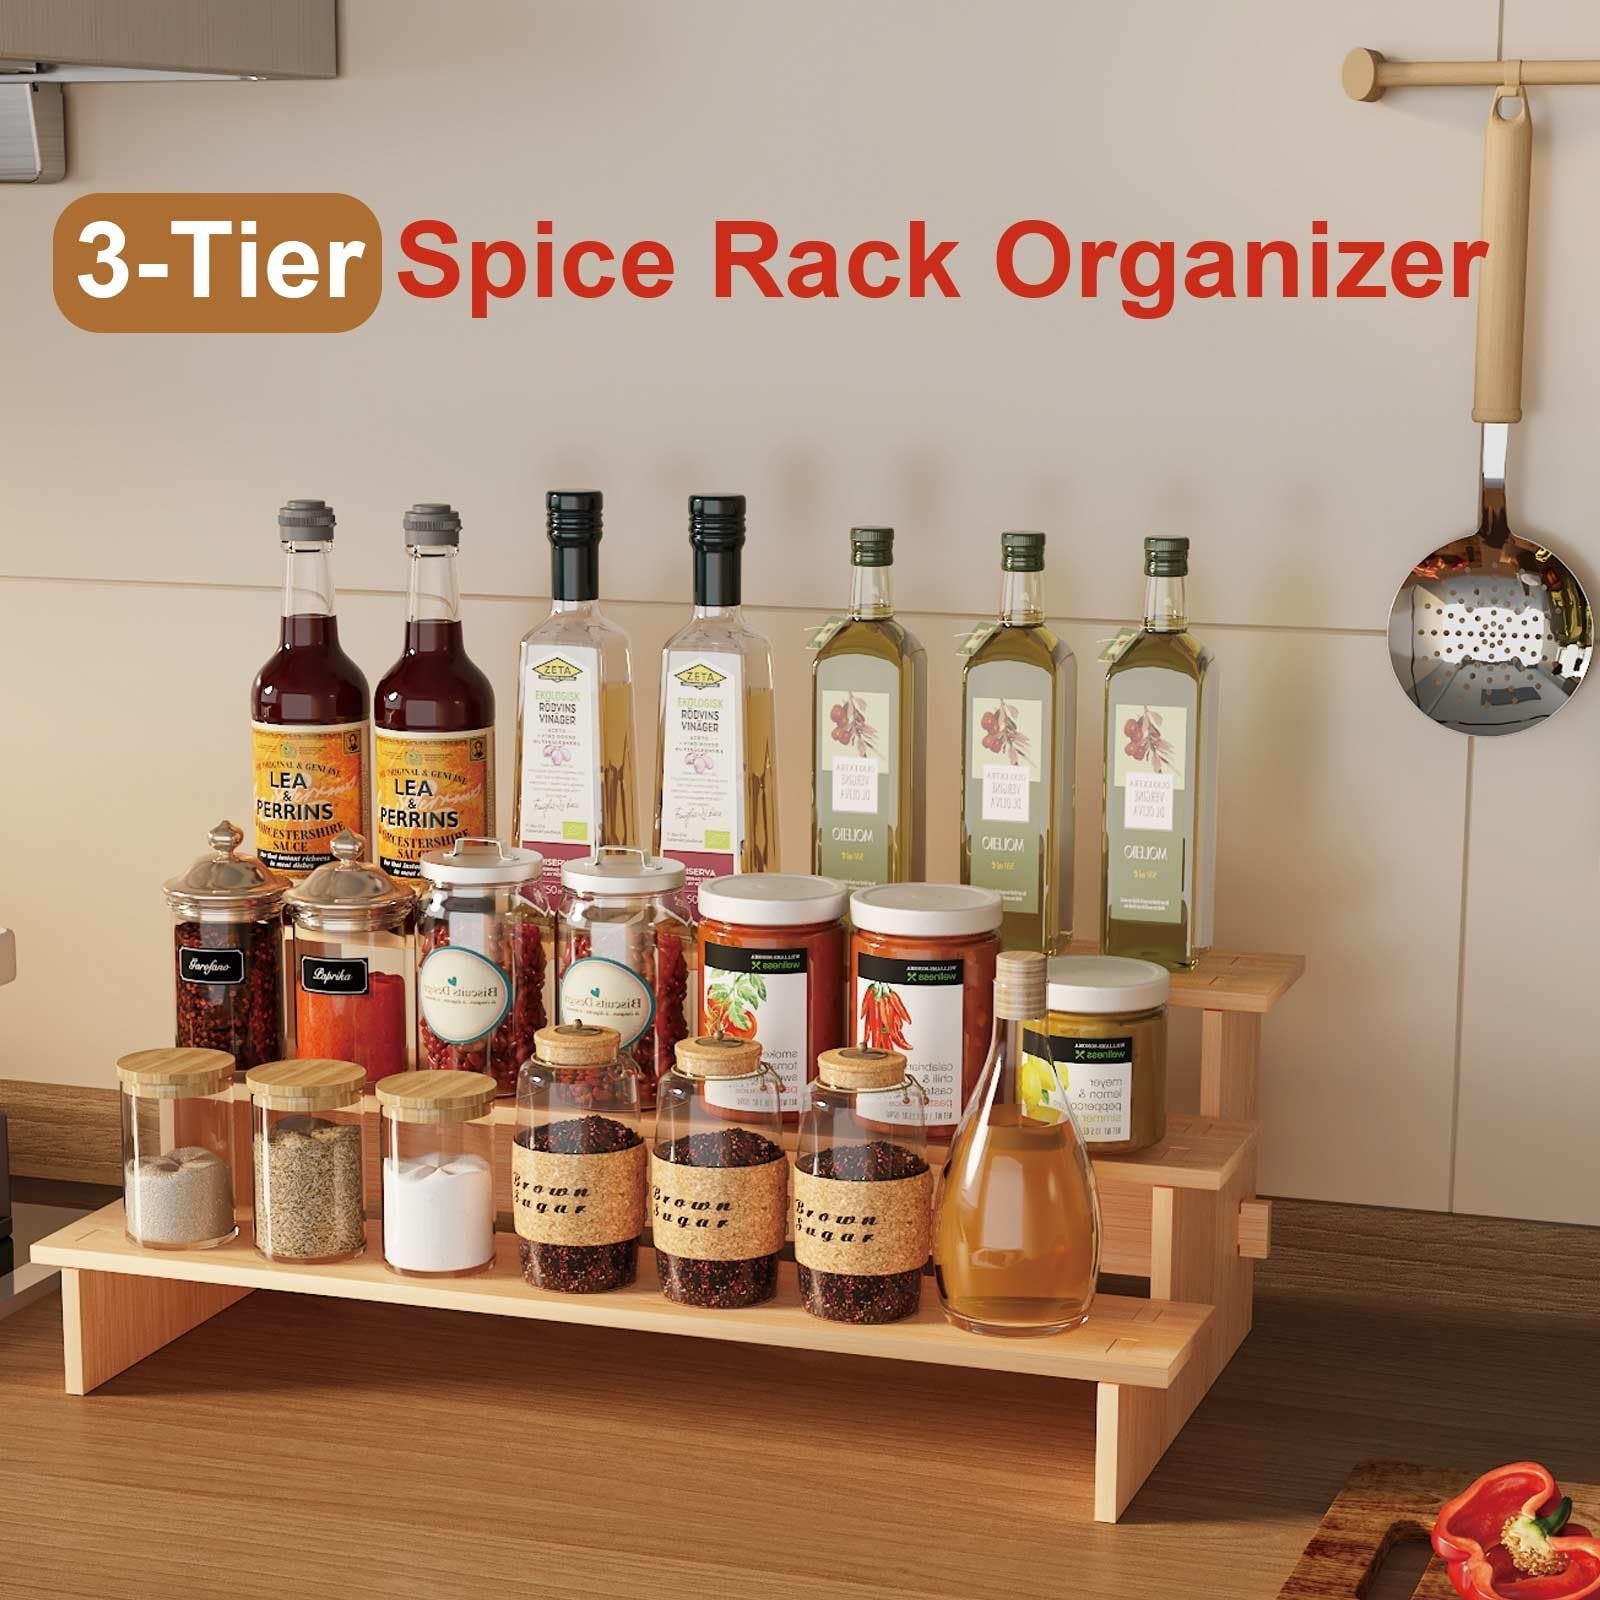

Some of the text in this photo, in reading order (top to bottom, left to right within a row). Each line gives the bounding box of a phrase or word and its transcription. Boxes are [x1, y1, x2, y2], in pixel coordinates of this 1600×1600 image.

[544, 665, 572, 675] ZETA
[687, 672, 715, 682] ZETA
[270, 771, 307, 789] LEA
[395, 778, 433, 796] LEA
[283, 790, 292, 801] &
[408, 798, 417, 809] &
[257, 800, 333, 820] PERRINS
[381, 807, 459, 828] PERRINS
[273, 841, 308, 852] SAUCE
[686, 868, 717, 877] ISERVA
[188, 957, 232, 975] Garofano
[313, 967, 353, 985] Paprika
[514, 1172, 590, 1198] Brown
[653, 1187, 733, 1211] Brown
[796, 1199, 879, 1226] Brown
